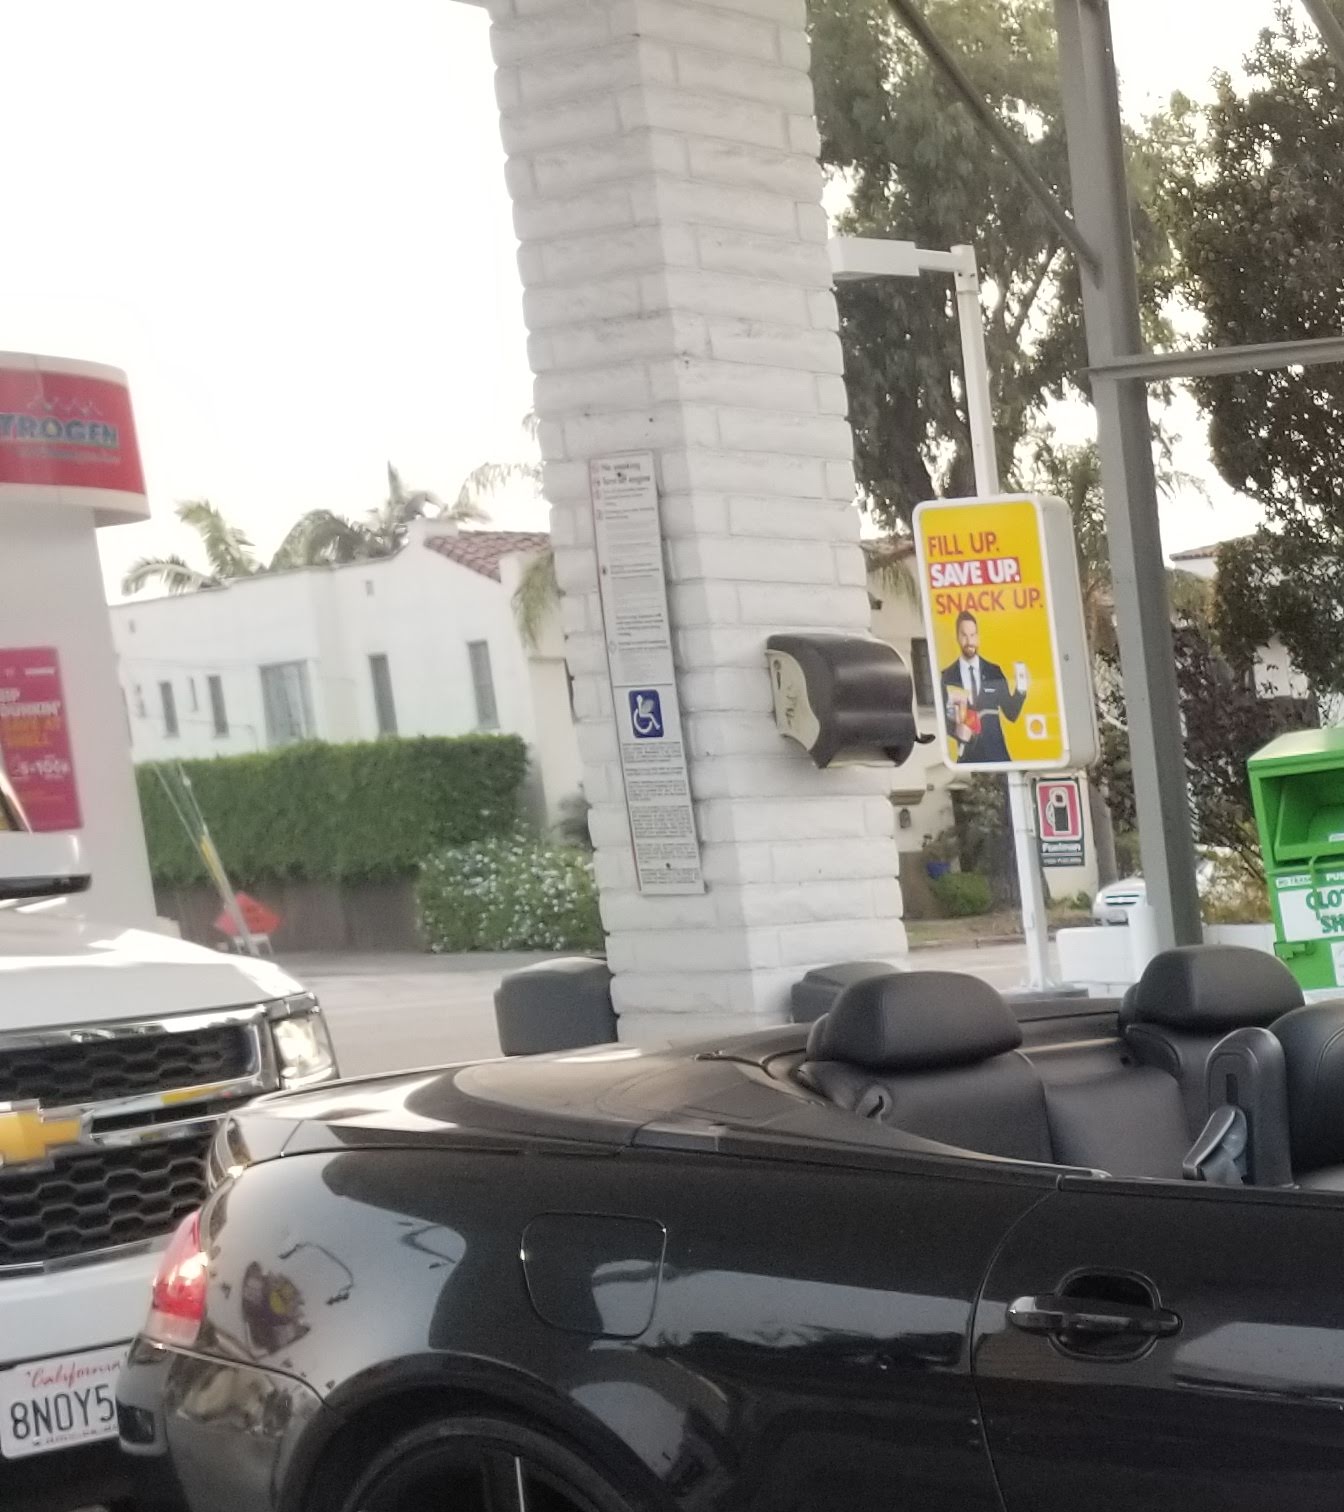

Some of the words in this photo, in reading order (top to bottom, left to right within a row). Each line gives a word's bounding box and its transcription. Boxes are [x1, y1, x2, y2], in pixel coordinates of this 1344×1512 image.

[928, 534, 964, 558] FILL
[970, 531, 1000, 554] UP.
[930, 561, 983, 588] SAVE
[987, 558, 1020, 584] UP.
[936, 591, 1005, 615] SNACK
[1013, 588, 1044, 609] UP.
